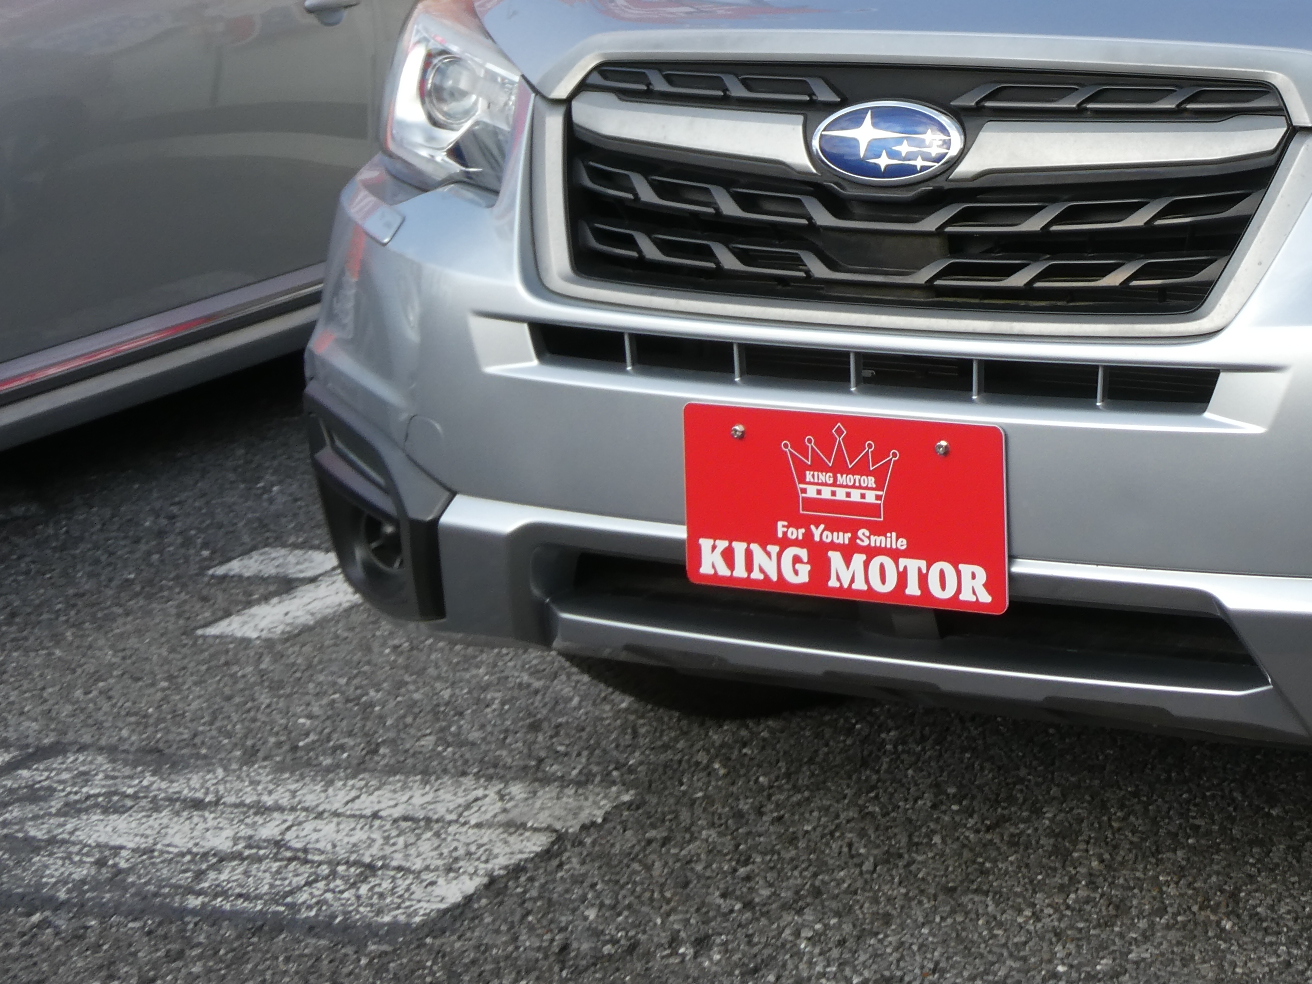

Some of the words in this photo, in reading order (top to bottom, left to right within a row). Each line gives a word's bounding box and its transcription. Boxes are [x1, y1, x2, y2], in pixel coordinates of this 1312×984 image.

[804, 470, 834, 484] KING
[836, 473, 877, 488] MOTOR
[776, 520, 806, 540] For
[810, 523, 852, 545] Your
[855, 528, 908, 550] Smile
[698, 537, 812, 585] KING
[827, 550, 993, 604] MOTOR
